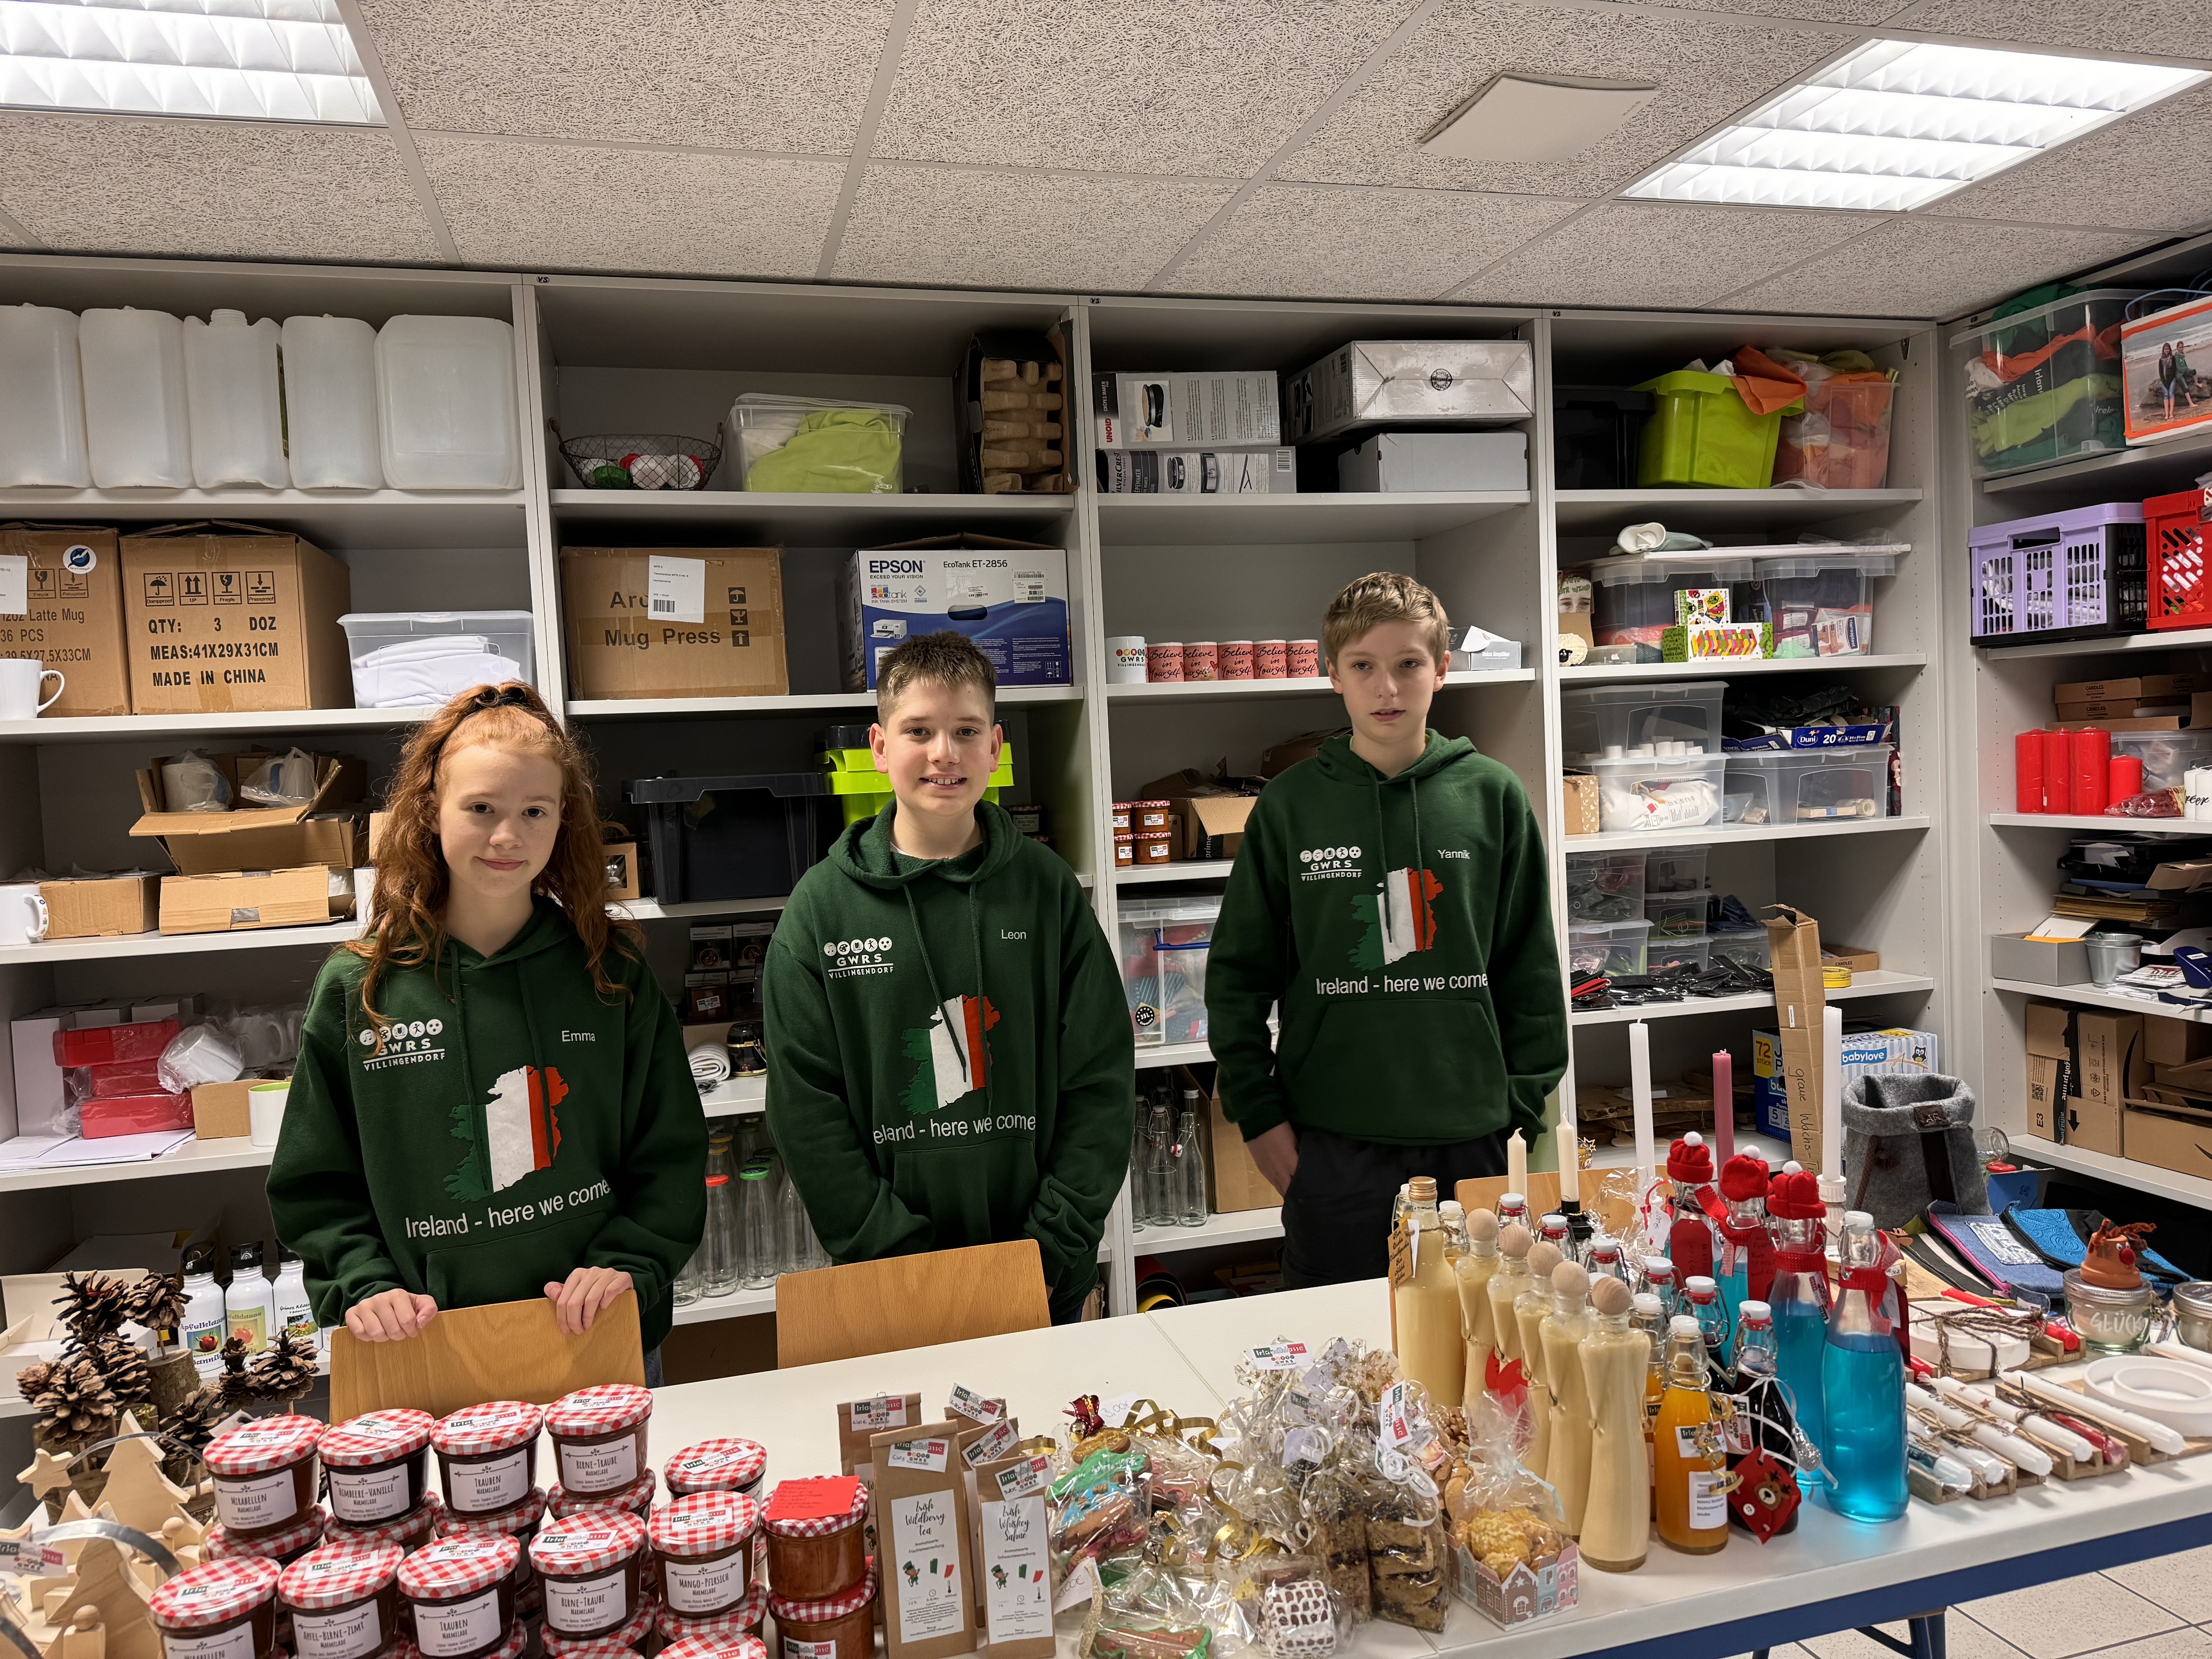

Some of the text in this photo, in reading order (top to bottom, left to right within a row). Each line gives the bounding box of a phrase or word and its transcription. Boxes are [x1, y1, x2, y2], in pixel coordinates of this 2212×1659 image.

[1105, 418, 1113, 443] UNOLD
[1114, 452, 1123, 493] ILVERCREST
[869, 560, 923, 573] EPSON
[972, 560, 1008, 568] ET-2856
[29, 608, 84, 624] Latte Mug
[148, 616, 277, 634] QTY: 3 DOZ
[0, 629, 44, 642] 36 PCS
[605, 628, 721, 650] Mug Press
[150, 642, 279, 660] MEAS:41X29X31CM
[1149, 649, 1183, 661] Believe
[1221, 646, 1254, 659] Believe
[1191, 659, 1200, 667] in
[153, 668, 266, 687] MADE IN CHINA
[1149, 667, 1181, 681] Yourself
[1184, 666, 1211, 678] ourself
[1221, 665, 1252, 678] Yourself
[1822, 734, 1836, 744] 20
[1310, 860, 1352, 871] GWRS
[1301, 872, 1362, 881] VILLINGENDORF
[1001, 929, 1027, 939] Leon
[836, 953, 883, 967] GWRS
[829, 966, 894, 979] VILLINGENDORF
[1316, 975, 1368, 994] Ireland
[1384, 975, 1419, 993] here
[1423, 977, 1445, 991] we
[1449, 973, 1488, 989] come
[562, 1030, 595, 1042] Emma
[377, 1038, 431, 1056] GWRS
[1755, 1040, 1771, 1059] 72
[364, 1052, 445, 1071] VILLINGENDORF
[1757, 1057, 1772, 1067] STÜCK
[1842, 1051, 1885, 1064] babylove
[1788, 1066, 1807, 1102] graue
[1772, 1109, 1779, 1120] 5
[2036, 1112, 2044, 1128] E3
[873, 1120, 915, 1144] eland
[930, 1118, 968, 1138] here
[973, 1117, 992, 1134] we
[996, 1114, 1036, 1131] come
[405, 1212, 469, 1239] Ireland
[488, 1204, 535, 1228] here
[538, 1195, 564, 1216] we
[568, 1177, 611, 1207] come
[2090, 1310, 2144, 1334] GLÜCK
[576, 1456, 617, 1469] BIRNE-TRAUBE
[585, 1468, 608, 1477] MARMELADE
[474, 1475, 501, 1487] TRAUBEN
[339, 1484, 395, 1498] HIMBEERE-VANILLE
[476, 1485, 500, 1494] MARMELADE
[231, 1494, 267, 1506] MIRABELLEN
[353, 1498, 377, 1506] MARMELADE
[916, 1498, 934, 1512] Irish
[237, 1504, 262, 1513] MARMELADE
[1003, 1503, 1020, 1518] Irish
[905, 1510, 945, 1526] Wildberry
[999, 1515, 1030, 1532] Whiskey
[1005, 1528, 1027, 1542] Sahne
[679, 1573, 729, 1589] MANGO-PFIRSICH
[692, 1587, 716, 1596] MARMELADE
[561, 1594, 605, 1607] BIRNE-TRAUBE
[571, 1607, 595, 1615] MARMELADE
[303, 1621, 365, 1642] APFEL-BIRNE-ZIMT
[440, 1618, 468, 1632] TRAUBEN
[442, 1628, 468, 1639] MARMELADE
[320, 1638, 347, 1649] MARMELADE
